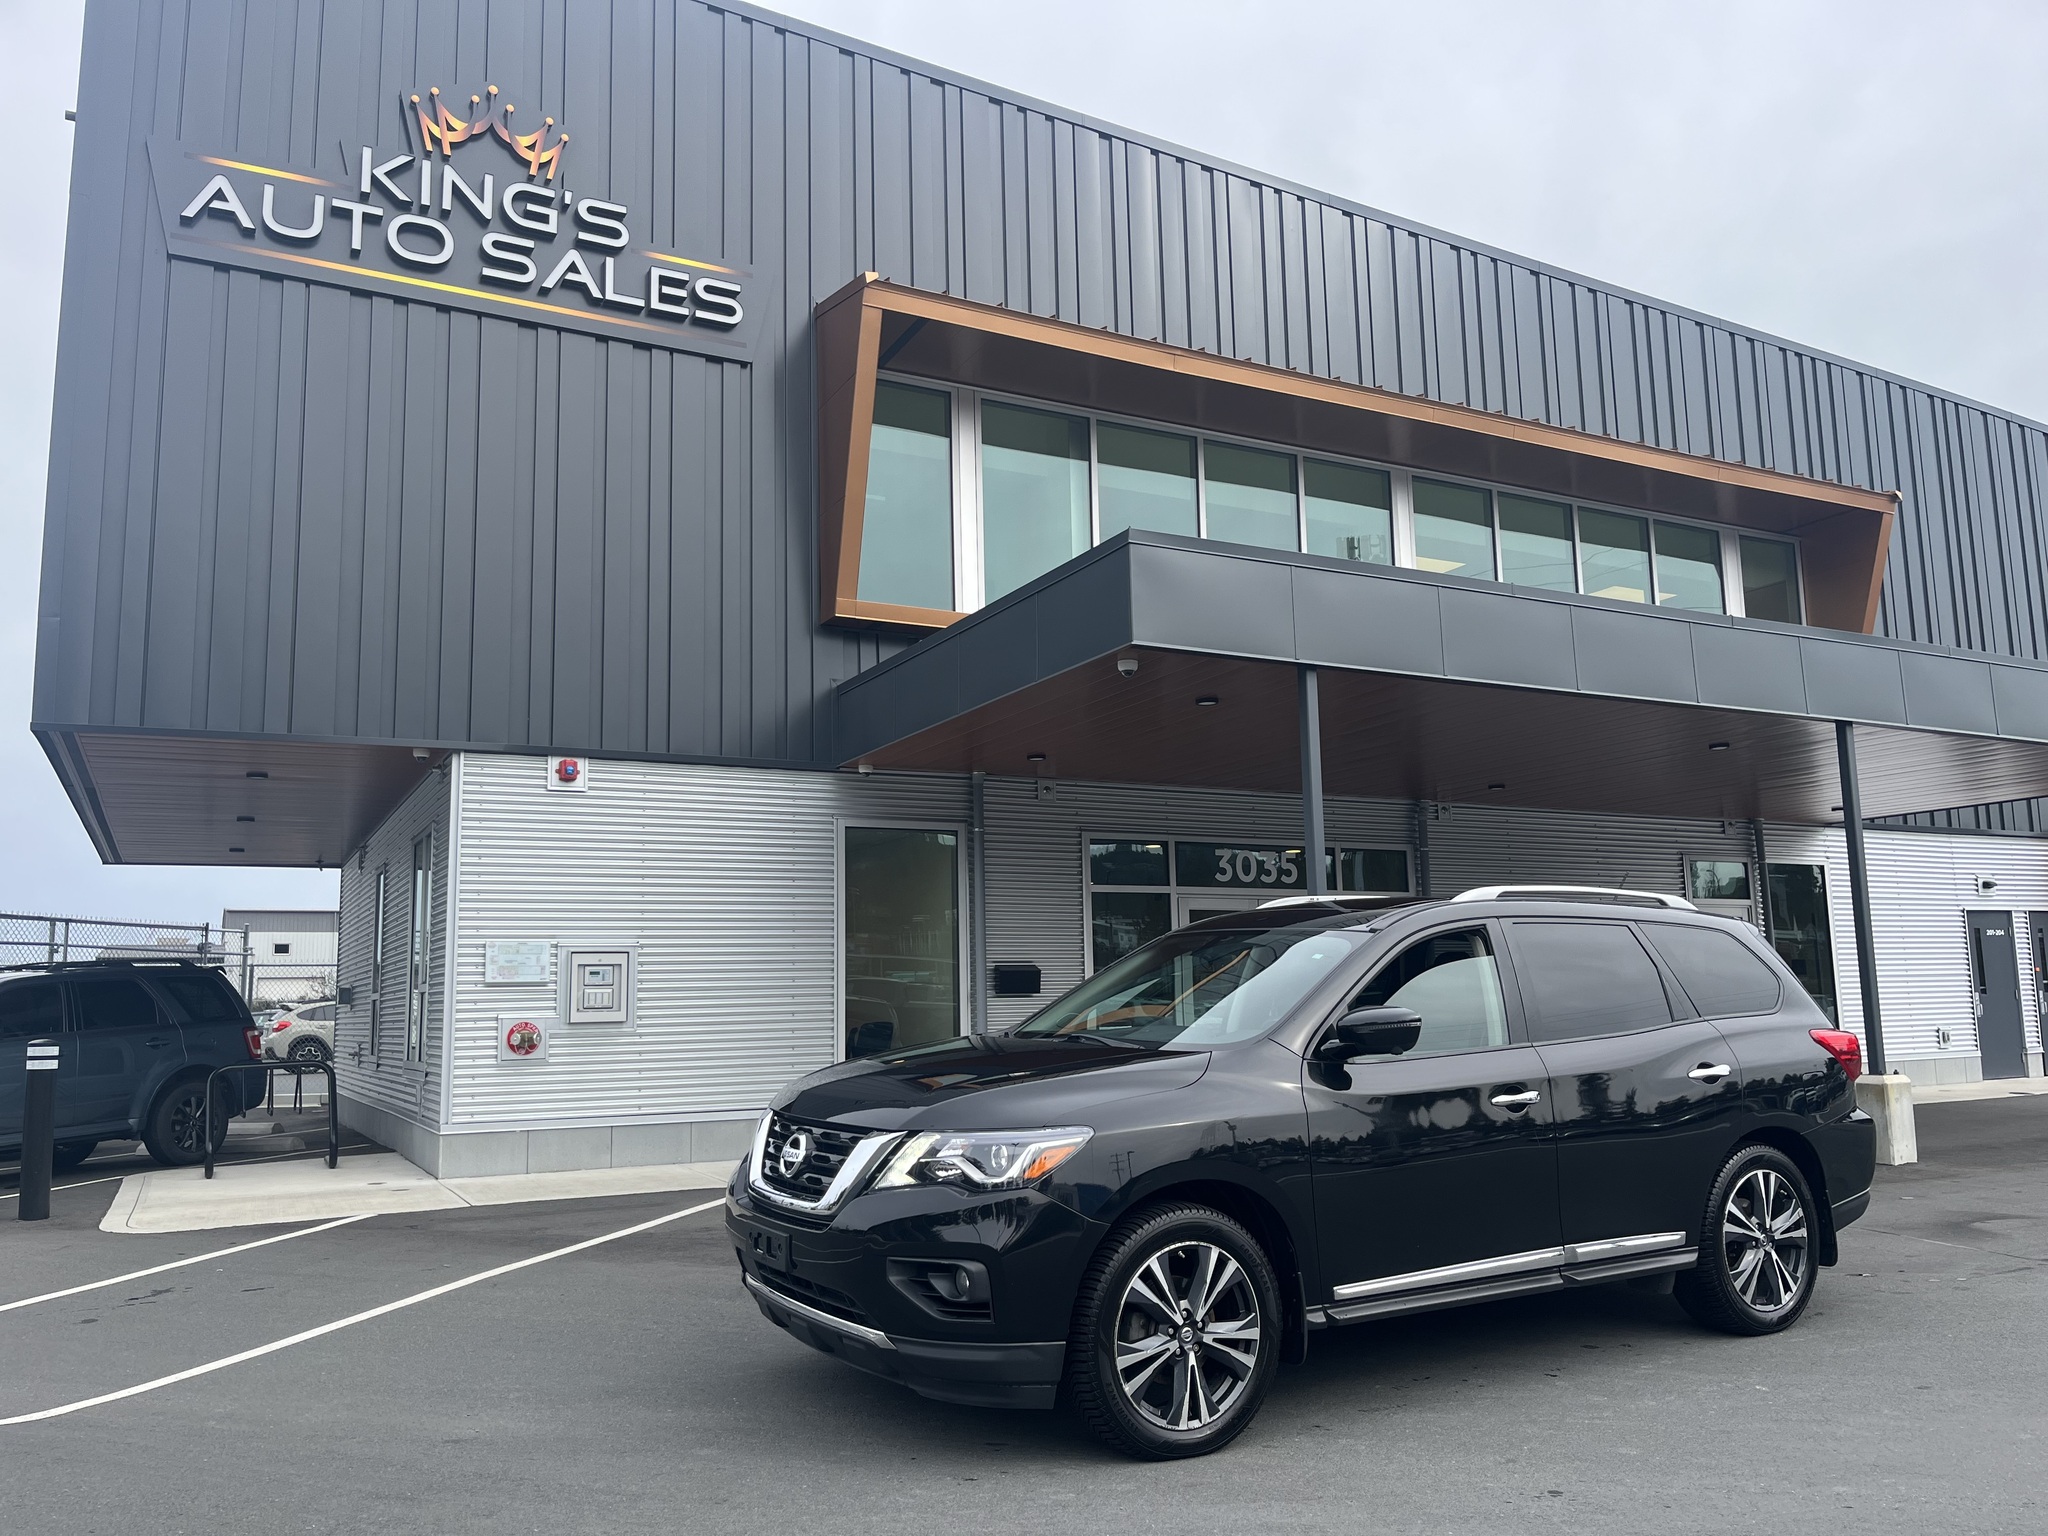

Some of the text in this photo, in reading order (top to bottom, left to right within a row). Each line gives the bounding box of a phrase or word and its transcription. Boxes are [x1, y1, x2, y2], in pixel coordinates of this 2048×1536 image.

[361, 145, 630, 249] KING'S
[180, 174, 744, 326] AUTO SALES
[1214, 848, 1298, 884] 3035
[512, 1022, 526, 1031] AUTO
